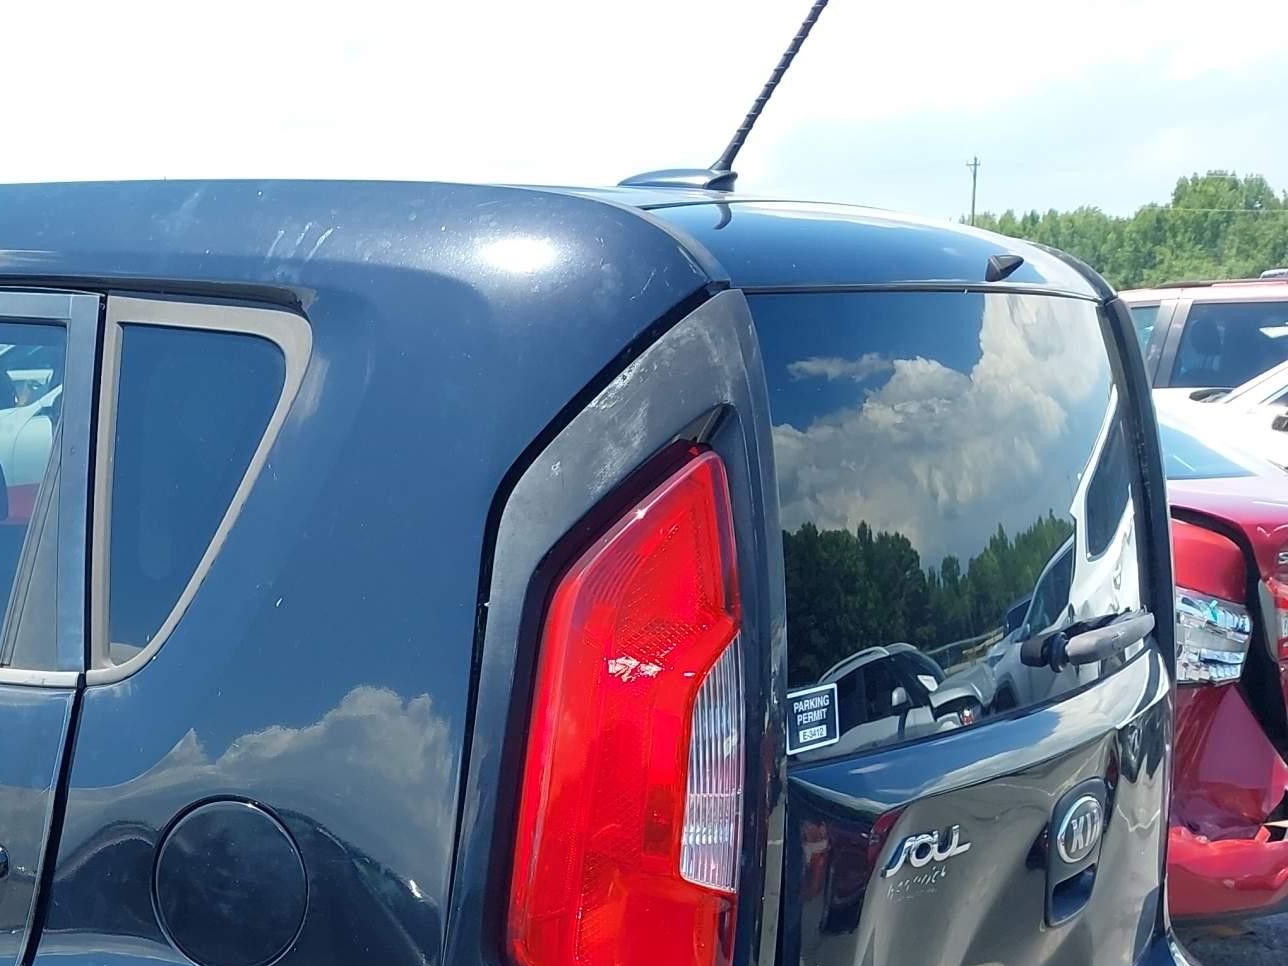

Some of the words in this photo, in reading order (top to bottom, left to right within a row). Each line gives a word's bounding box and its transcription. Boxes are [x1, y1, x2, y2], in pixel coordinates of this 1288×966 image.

[793, 694, 830, 714] PARKING
[797, 708, 828, 726] PERMIT
[1070, 808, 1100, 853] KIA
[880, 824, 972, 879] SOUL
